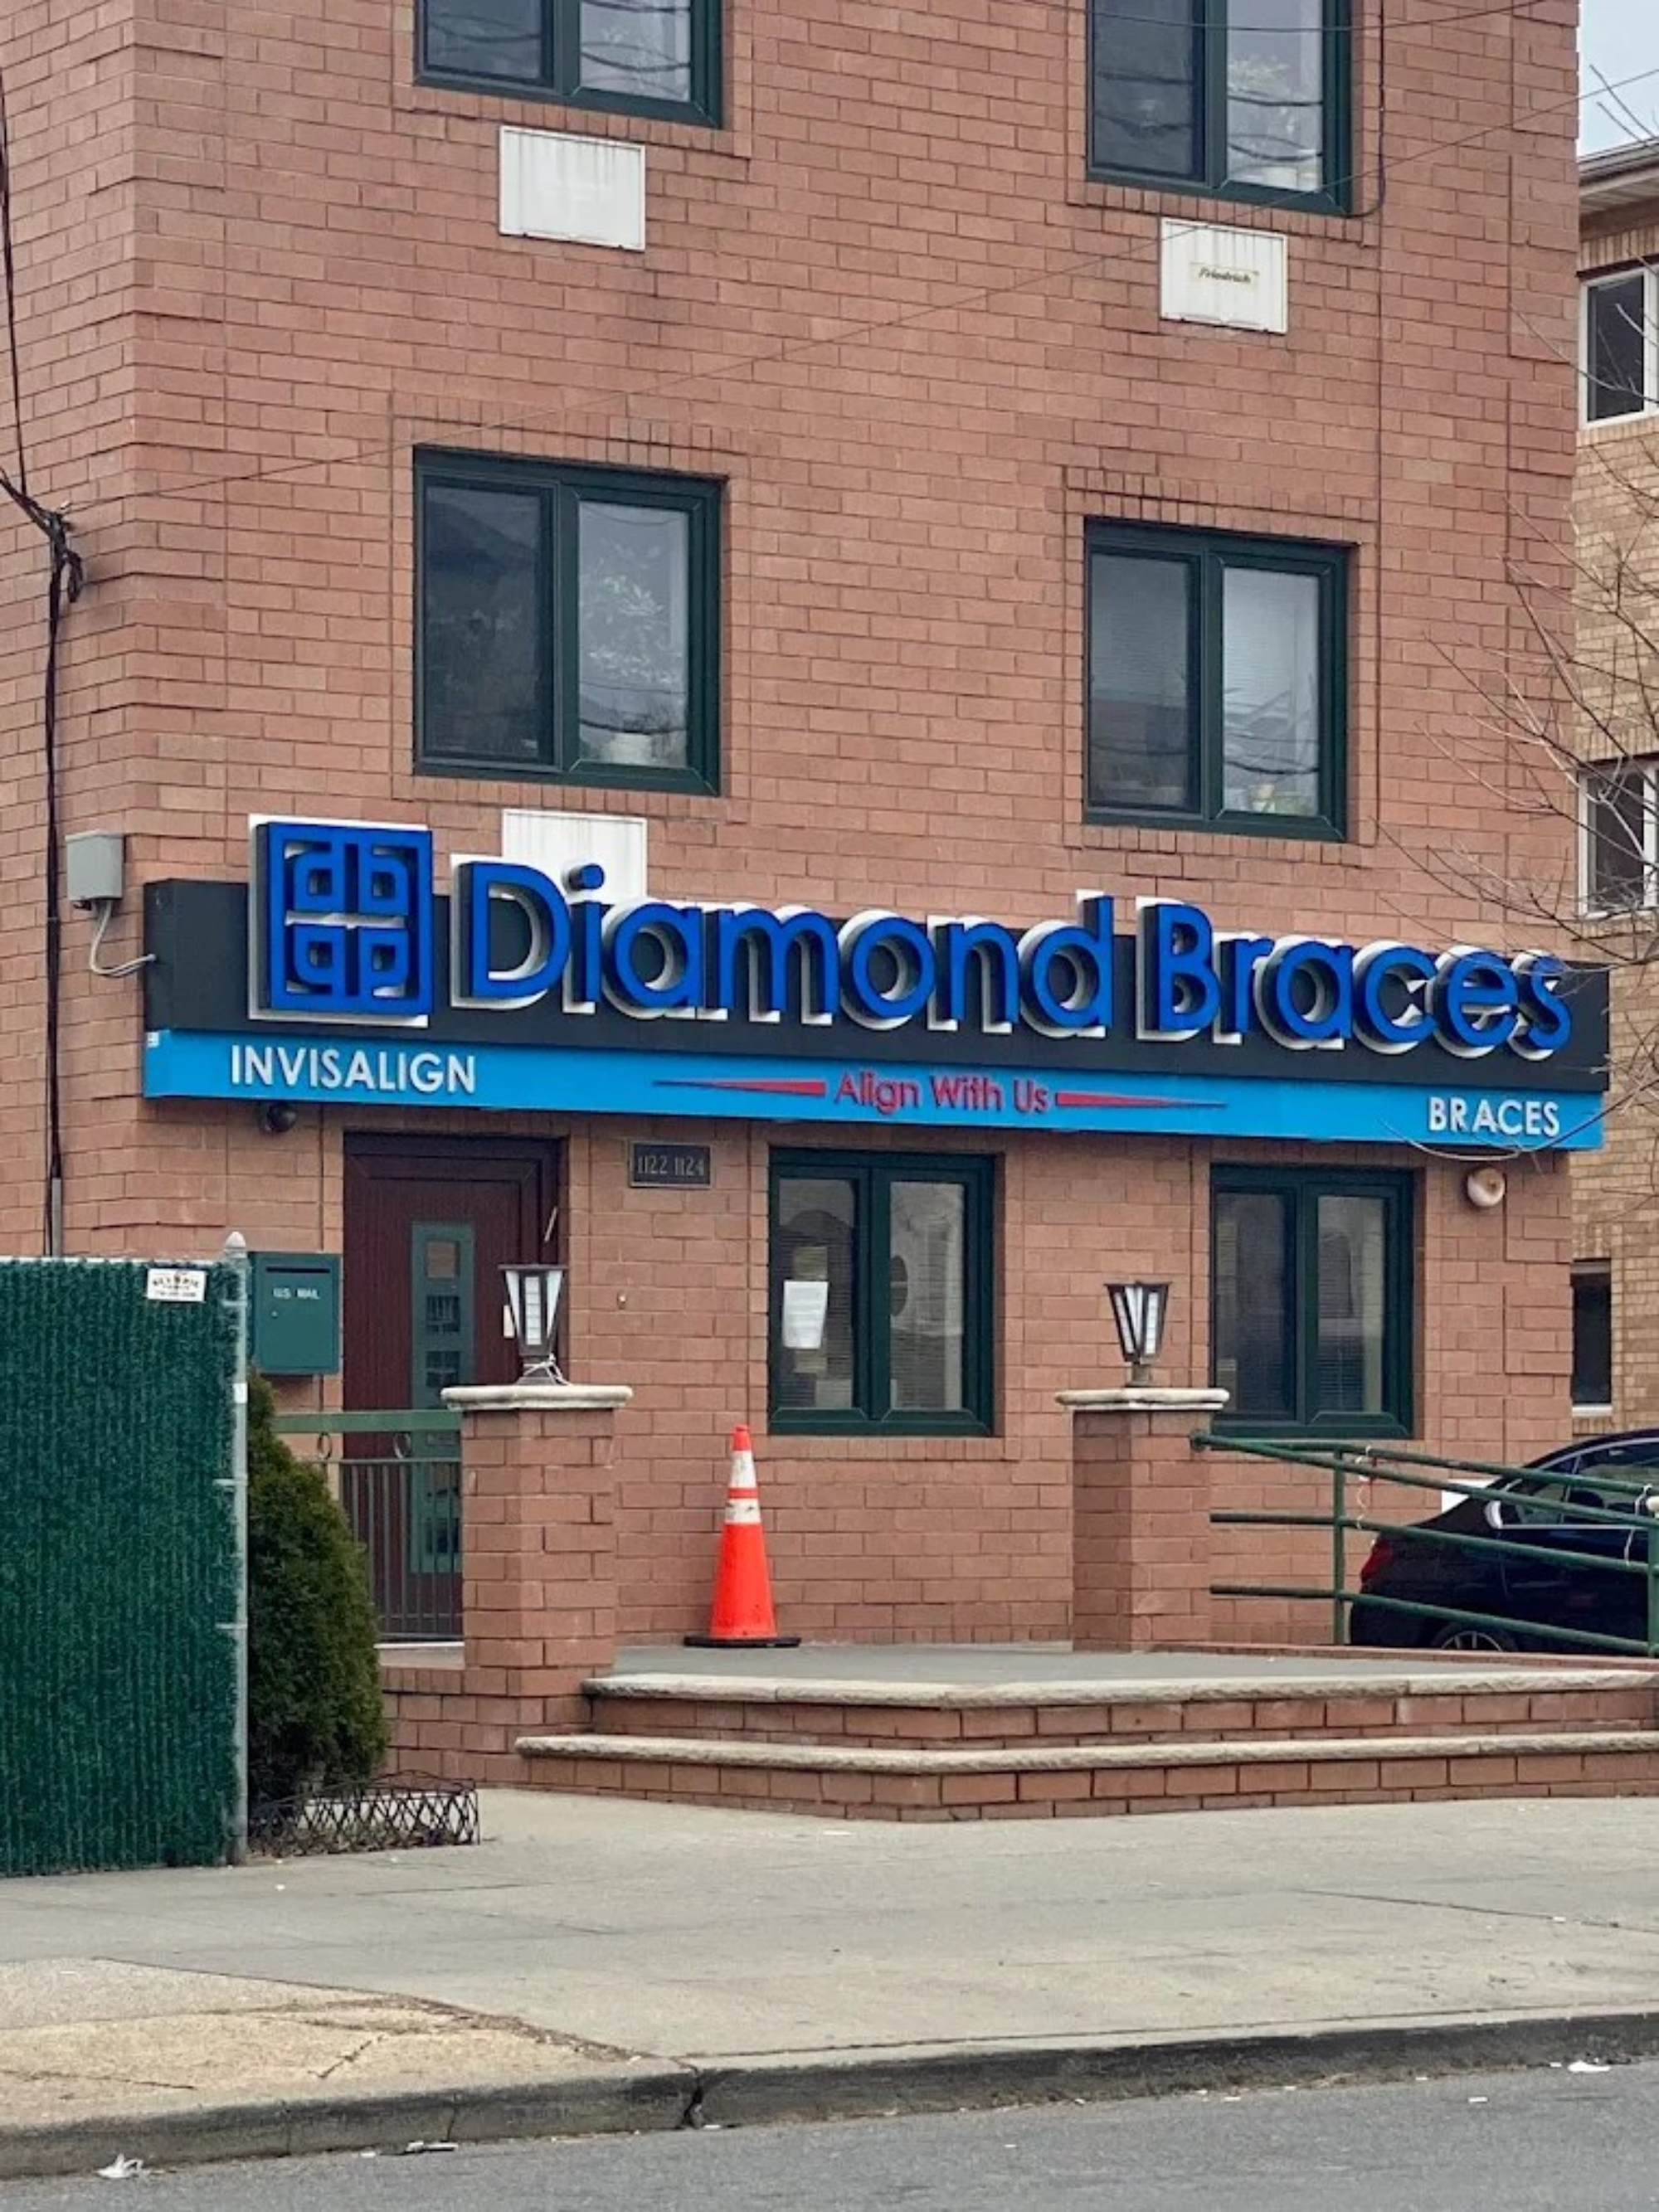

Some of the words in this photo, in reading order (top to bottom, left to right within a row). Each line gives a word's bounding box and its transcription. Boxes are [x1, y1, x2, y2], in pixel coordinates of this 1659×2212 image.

[450, 856, 1115, 1039] Diamond
[1136, 897, 1573, 1061] Braces
[231, 1044, 476, 1095] INVISALIGN
[836, 1070, 920, 1115] Align
[931, 1075, 1003, 1112] With
[1013, 1078, 1048, 1114] Us
[1429, 1096, 1559, 1137] BRACES
